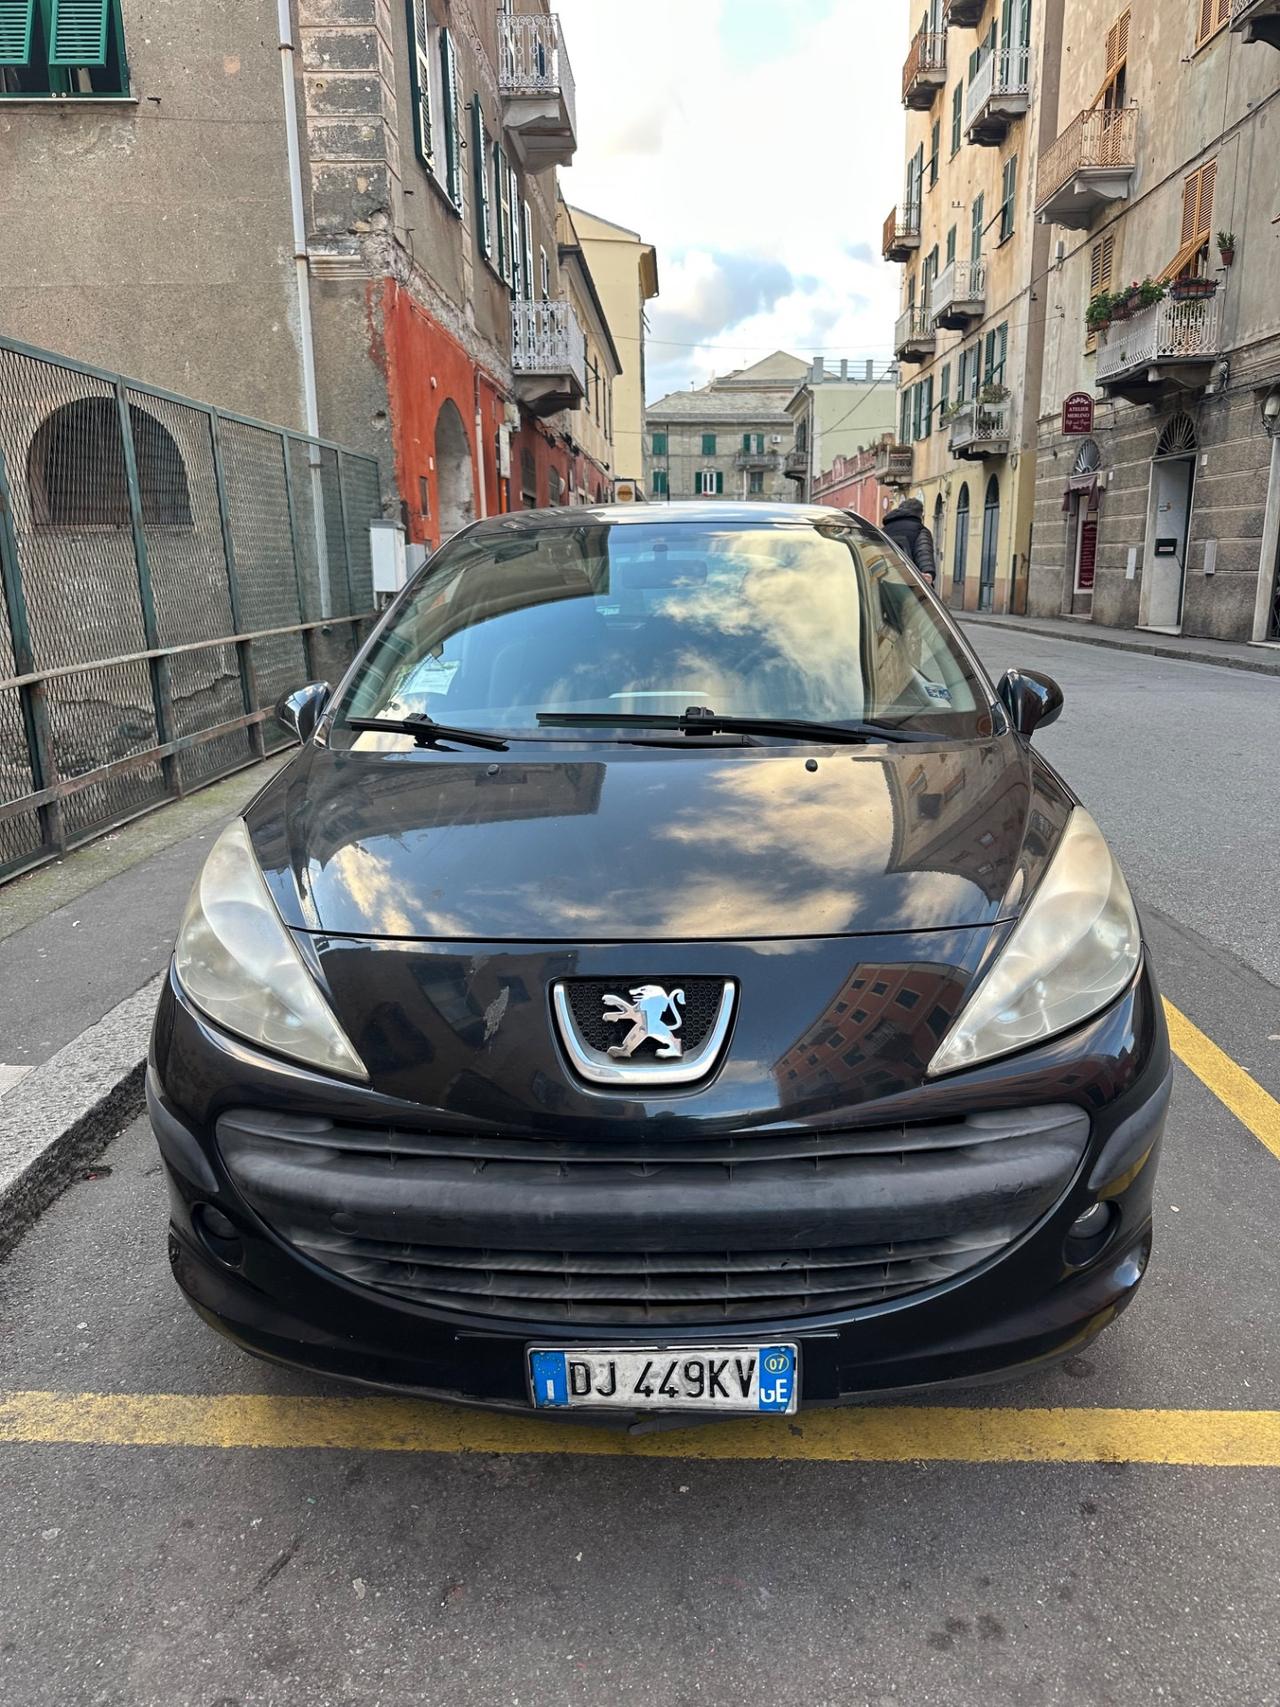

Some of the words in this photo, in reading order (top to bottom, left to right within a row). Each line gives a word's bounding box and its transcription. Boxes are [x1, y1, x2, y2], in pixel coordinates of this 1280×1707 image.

[769, 1358, 784, 1370] 07
[569, 1361, 617, 1397] DJ
[633, 1359, 757, 1398] 449KV
